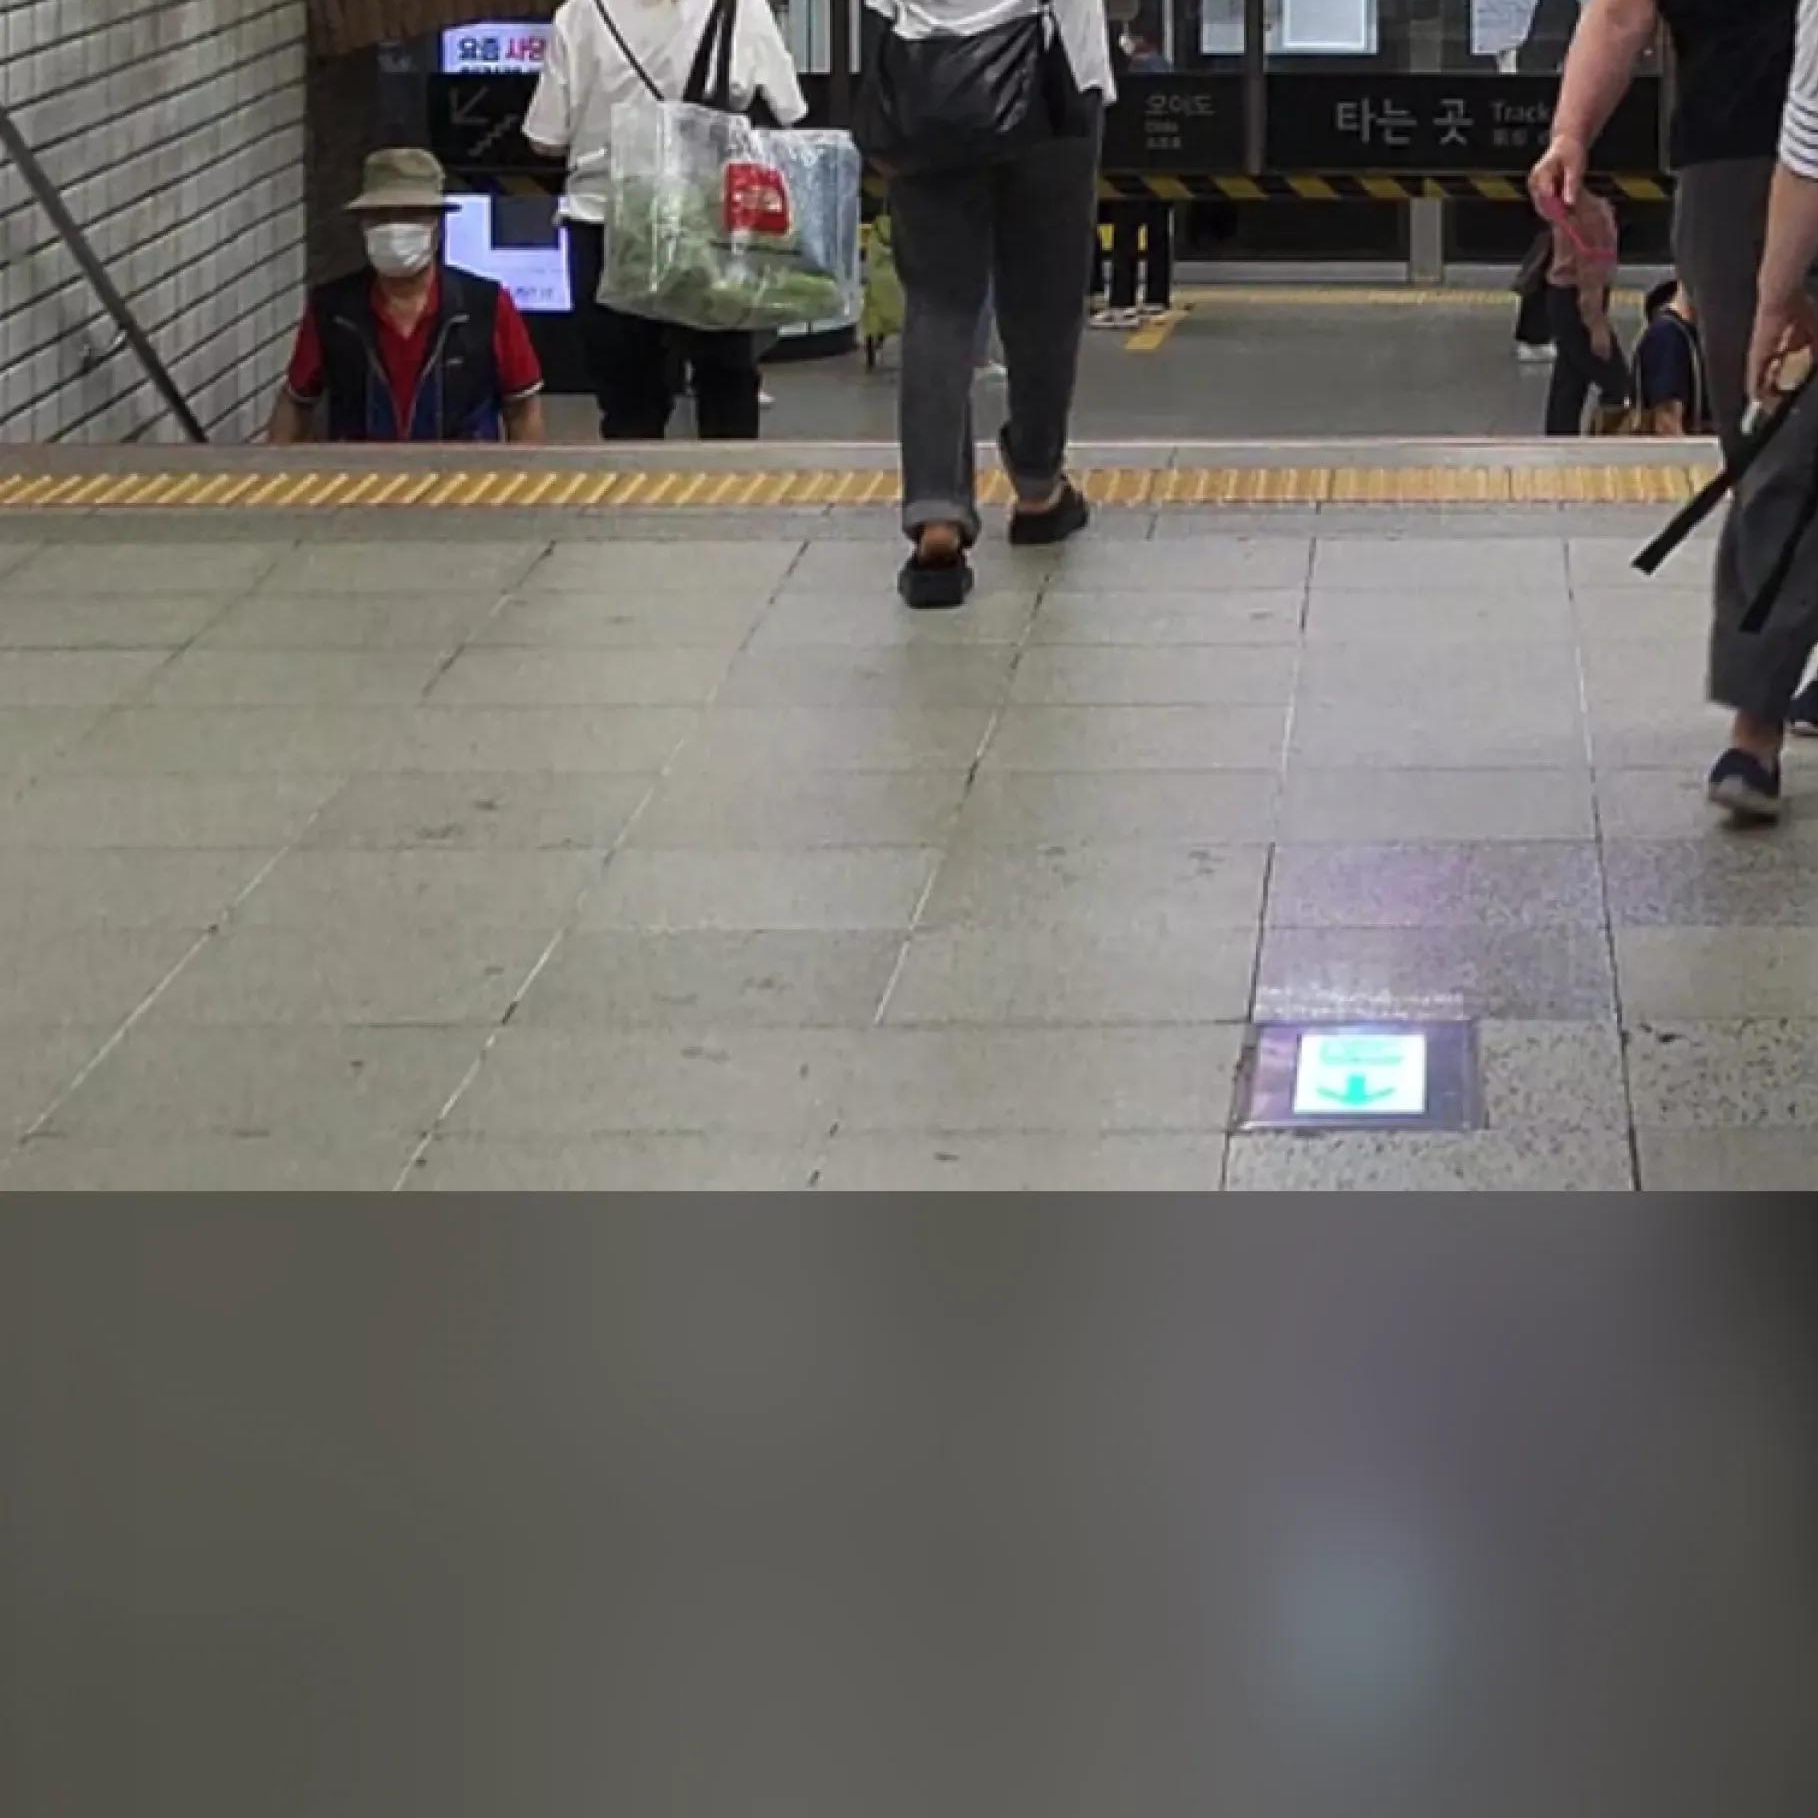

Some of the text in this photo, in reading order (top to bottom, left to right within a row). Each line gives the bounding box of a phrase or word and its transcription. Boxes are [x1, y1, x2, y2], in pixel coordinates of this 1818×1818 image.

[1144, 93, 1215, 117] 오이도
[1336, 97, 1475, 145] 타는 곳
